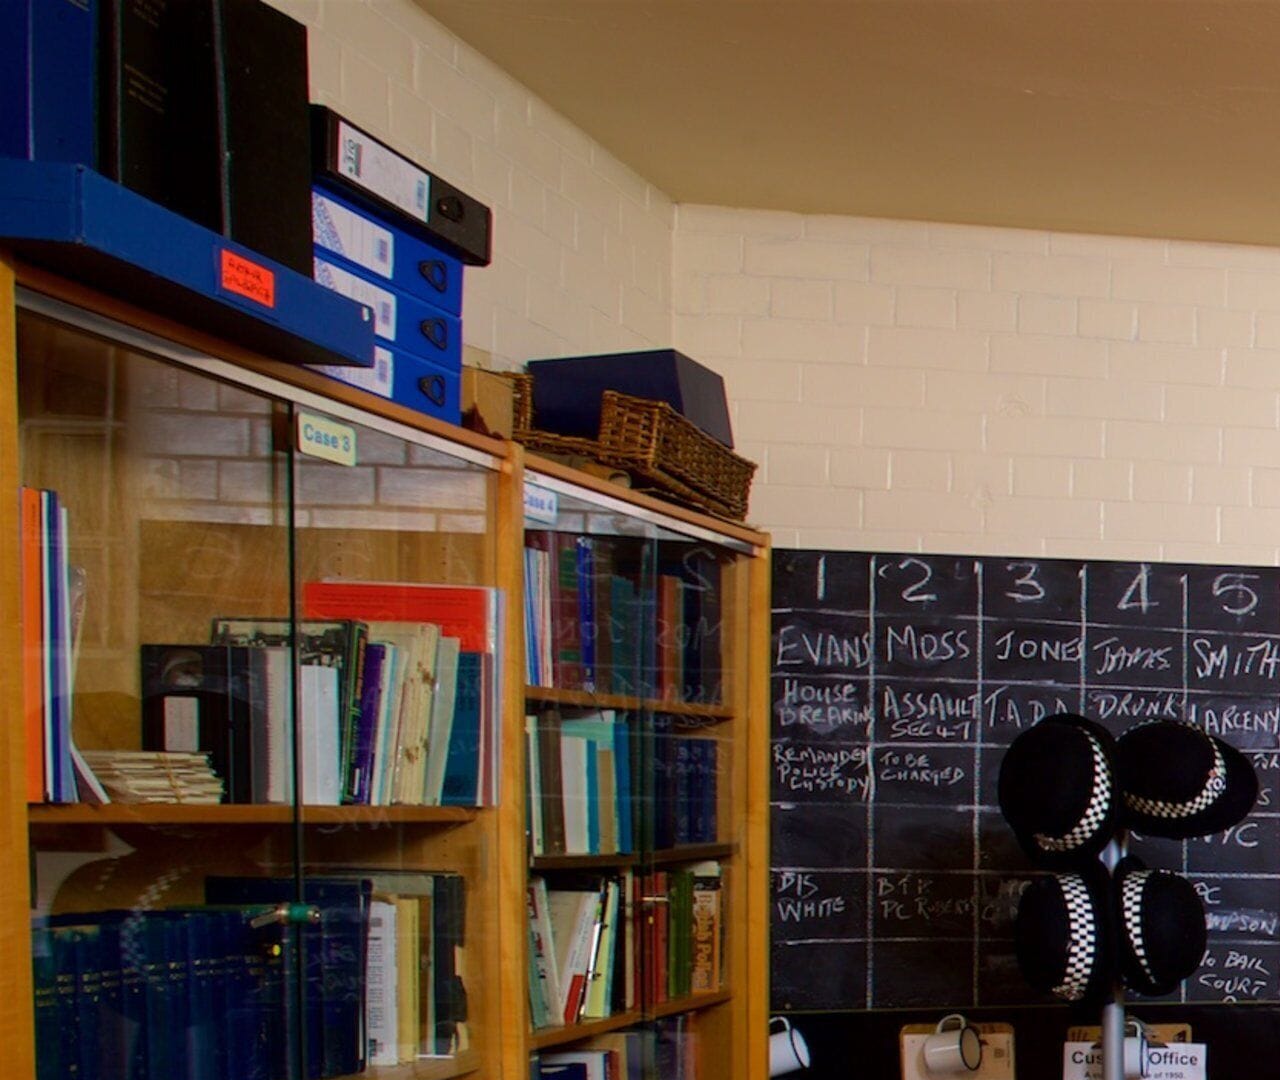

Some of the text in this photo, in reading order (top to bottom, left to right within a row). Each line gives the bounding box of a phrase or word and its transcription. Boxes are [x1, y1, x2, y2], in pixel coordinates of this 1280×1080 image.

[303, 423, 339, 449] Case
[524, 491, 545, 510] ase
[816, 555, 826, 600] 1
[899, 558, 938, 602] 2
[1005, 561, 1045, 602] 3
[1117, 563, 1160, 614] 4
[1212, 572, 1260, 616] 5
[776, 624, 871, 668] EVANS
[886, 625, 971, 662] MOSS
[1192, 638, 1280, 679] SMITH
[784, 679, 856, 704] HOUSE
[883, 685, 982, 721] ASSAULT
[891, 720, 932, 738] SEC
[904, 753, 931, 768] BE
[1150, 1051, 1199, 1066] Office
